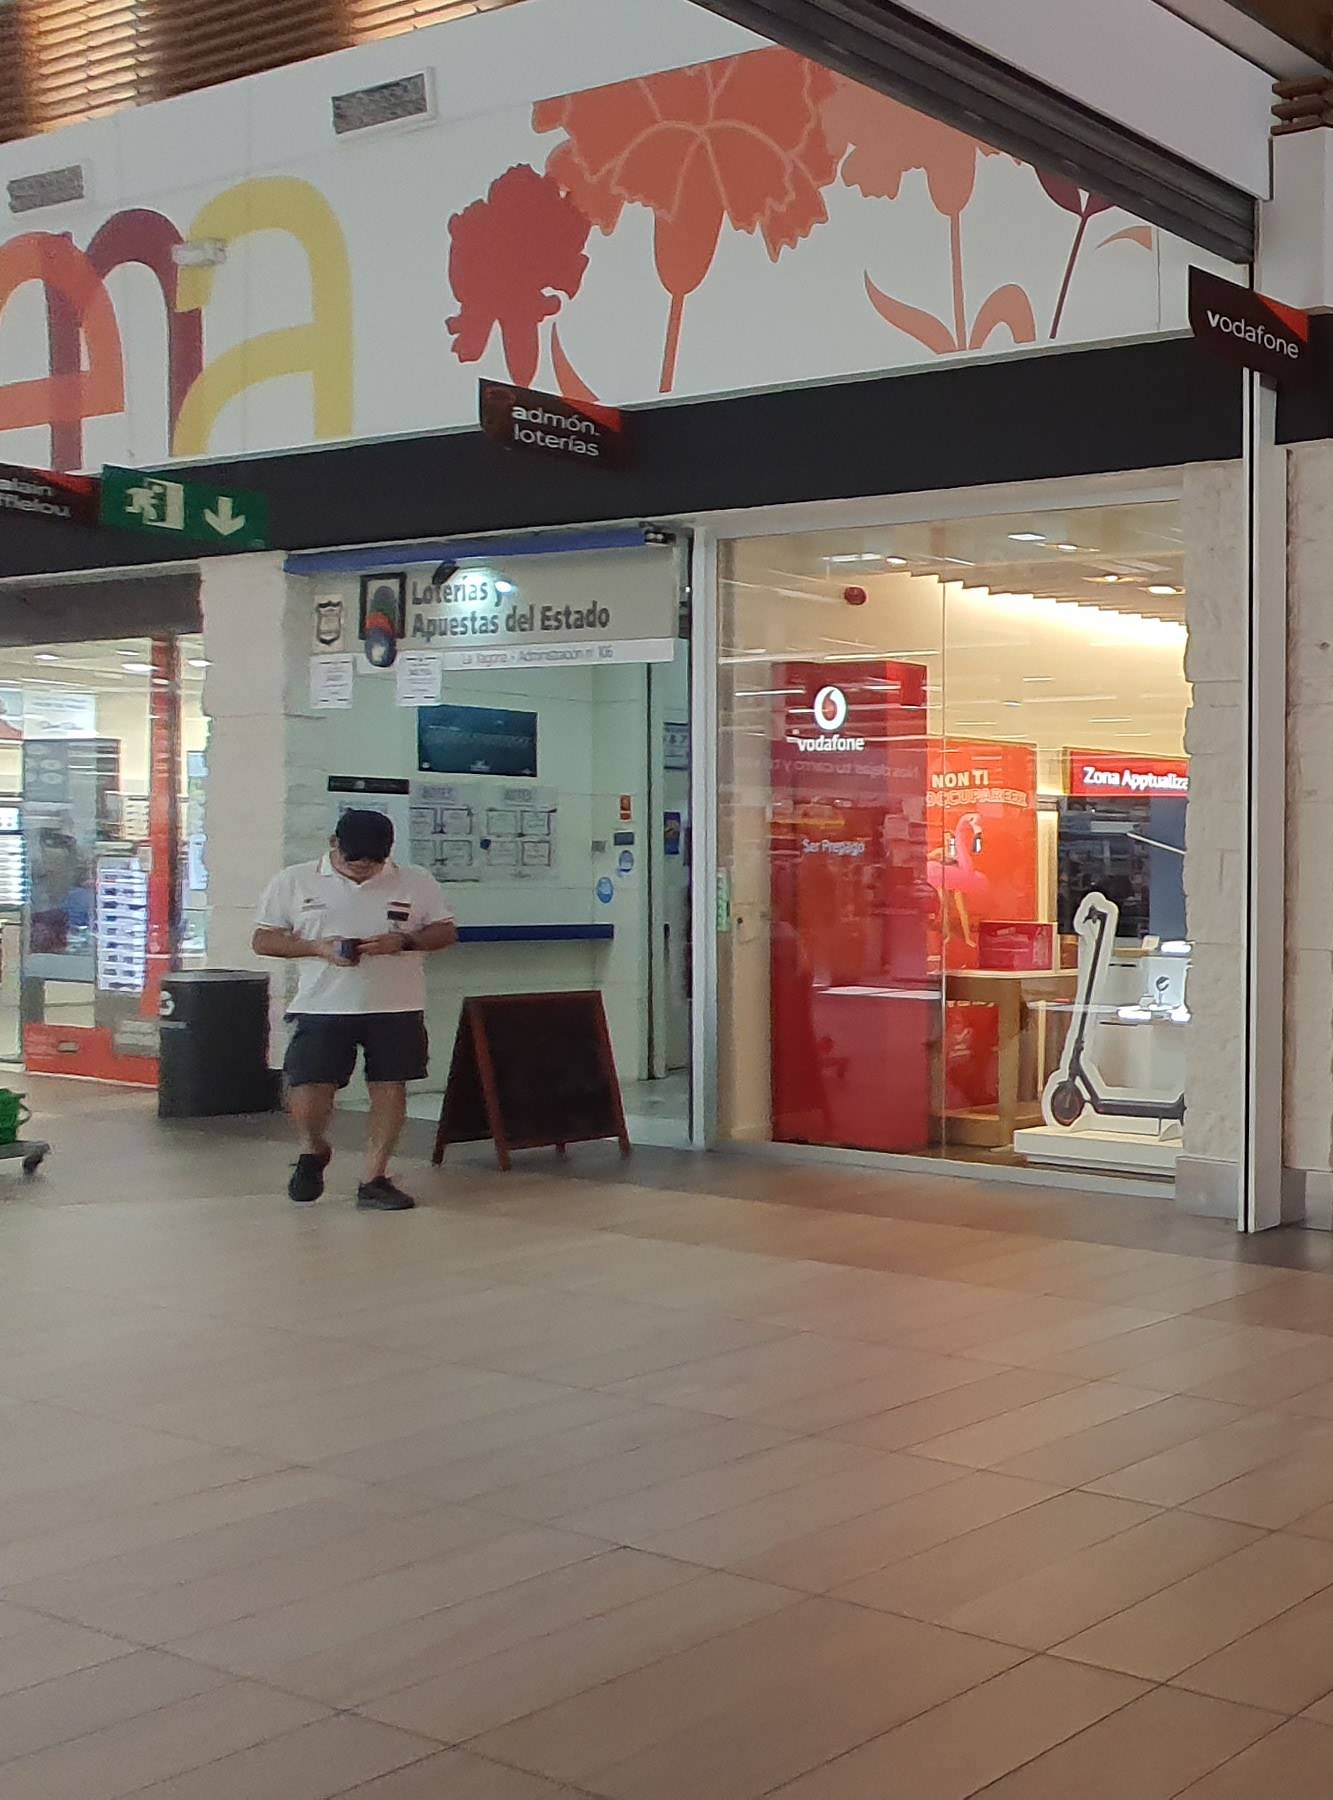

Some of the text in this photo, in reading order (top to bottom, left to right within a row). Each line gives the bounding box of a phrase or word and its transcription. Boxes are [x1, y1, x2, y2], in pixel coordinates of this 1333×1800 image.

[1206, 310, 1299, 359] vodafone
[511, 405, 601, 436] admón.
[513, 423, 600, 457] loterías
[411, 575, 489, 606] Loterías
[411, 600, 610, 642] Apuestas del Estado
[798, 734, 866, 752] vodafone
[931, 769, 989, 788] NON TI
[1082, 767, 1120, 786] Zona
